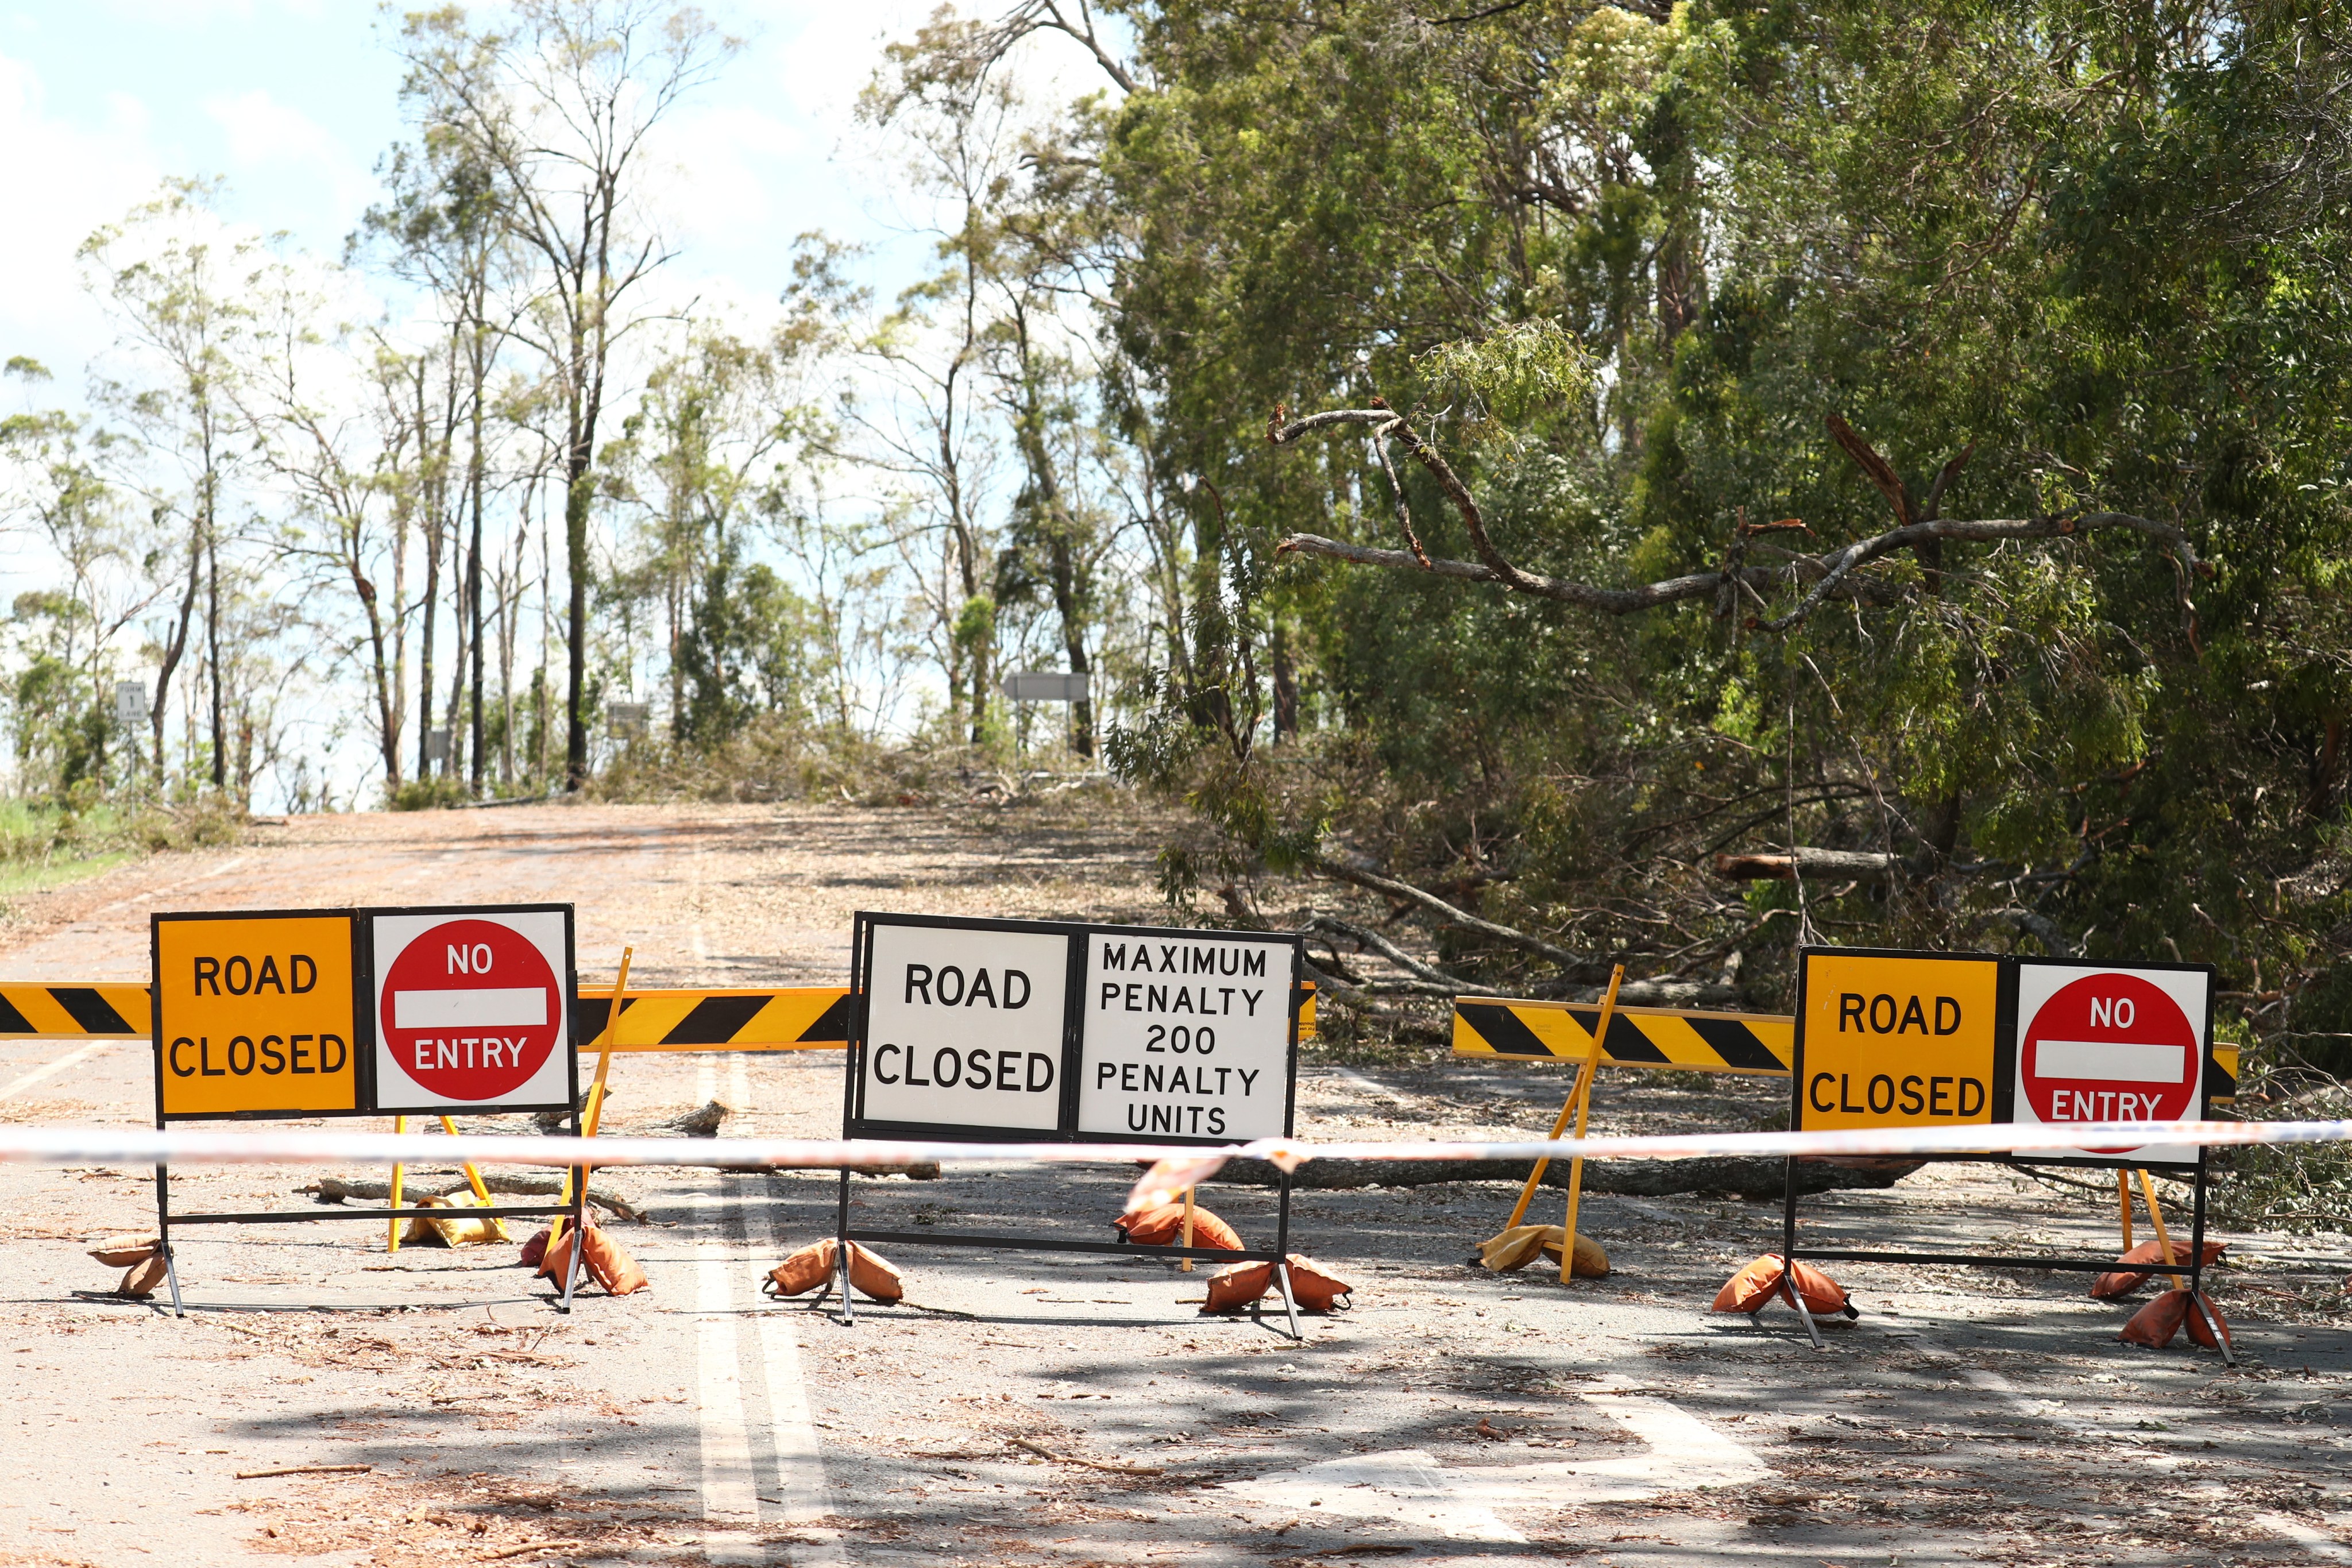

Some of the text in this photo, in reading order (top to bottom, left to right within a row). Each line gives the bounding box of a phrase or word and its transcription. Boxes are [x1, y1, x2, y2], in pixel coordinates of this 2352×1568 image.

[129, 695, 134, 708] 1
[195, 955, 316, 995] ROAD
[448, 944, 492, 974] NO
[1103, 943, 1266, 977] MAXIMUM
[905, 964, 1030, 1009] ROAD
[1102, 983, 1263, 1016] PENALTY
[1840, 994, 1961, 1035] ROAD
[2091, 997, 2134, 1028] NO
[170, 1034, 346, 1077] CLOSED
[416, 1037, 527, 1069] ENTRY
[1146, 1025, 1215, 1055] 200
[874, 1044, 1053, 1092] CLOSED
[1098, 1063, 1259, 1096] PENALTY
[1810, 1072, 1984, 1116] CLOSED
[2053, 1090, 2162, 1121] ENTRY
[1128, 1104, 1225, 1136] UNITS
